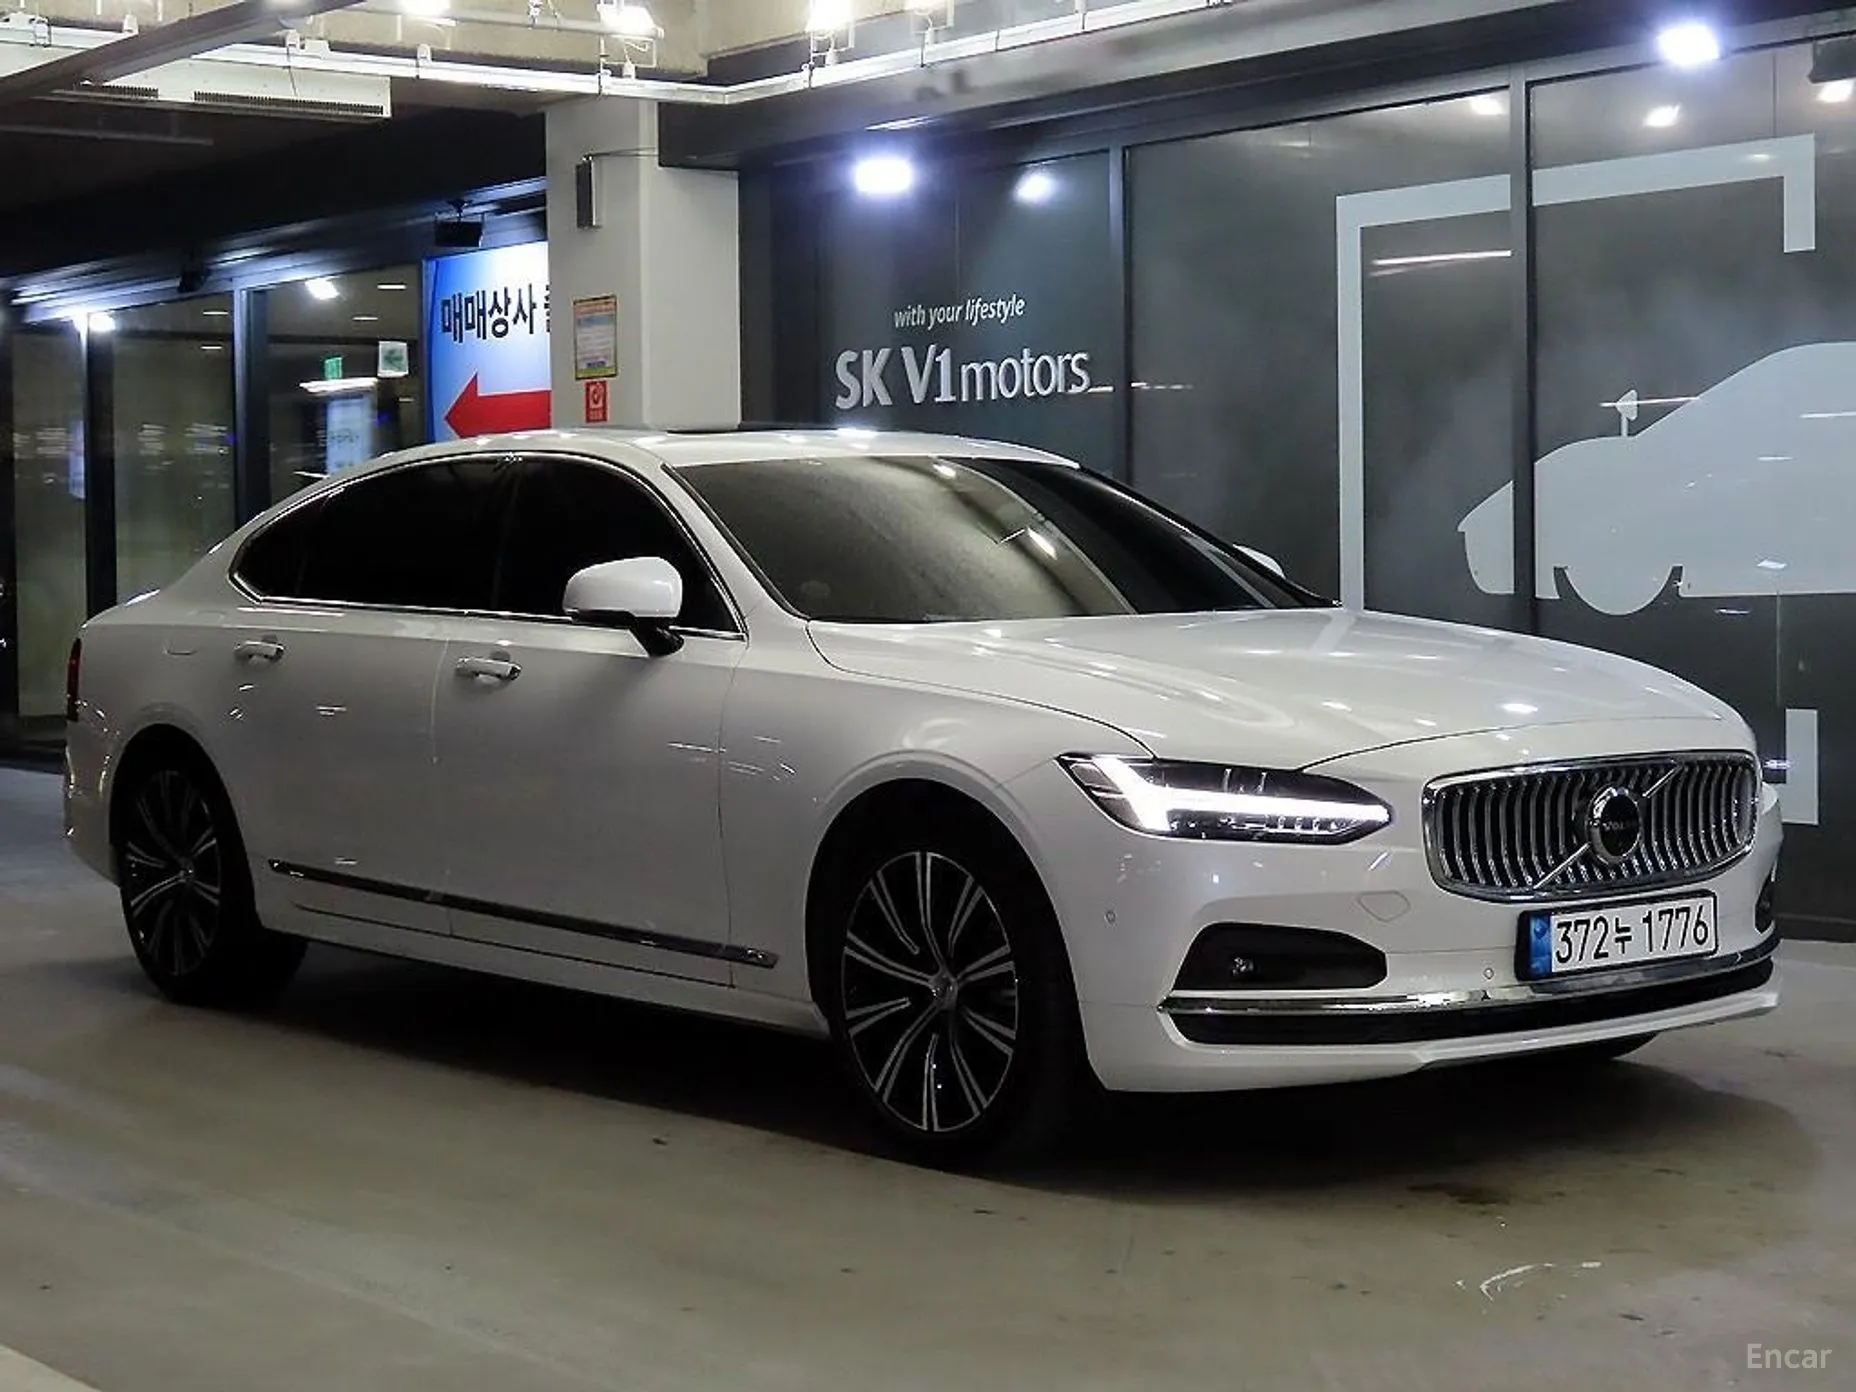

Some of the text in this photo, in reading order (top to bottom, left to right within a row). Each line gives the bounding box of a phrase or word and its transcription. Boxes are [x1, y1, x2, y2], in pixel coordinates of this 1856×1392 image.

[440, 283, 537, 344] 매매상사
[894, 293, 1026, 330] with your lifestyle
[834, 347, 893, 410] SK
[1555, 904, 1709, 964] 372누 1776
